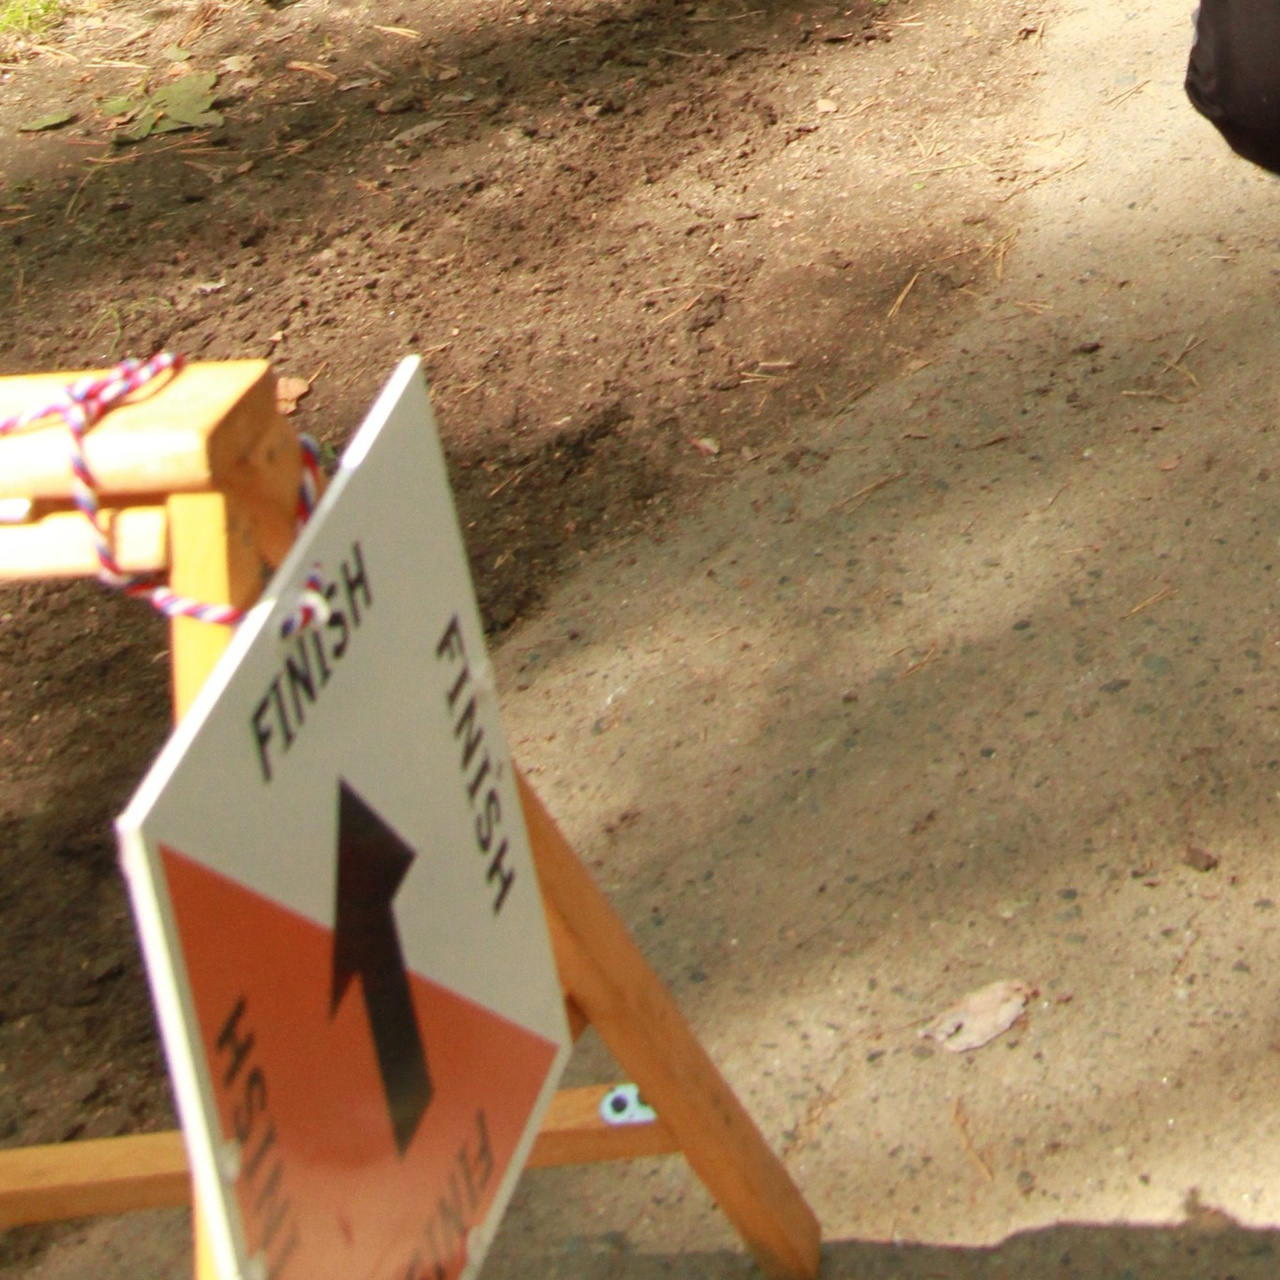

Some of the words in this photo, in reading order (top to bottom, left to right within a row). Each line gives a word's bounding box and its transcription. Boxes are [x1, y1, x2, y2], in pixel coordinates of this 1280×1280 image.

[250, 540, 373, 783] FINISH
[435, 611, 515, 916] FINISH
[216, 993, 300, 1280] INISH
